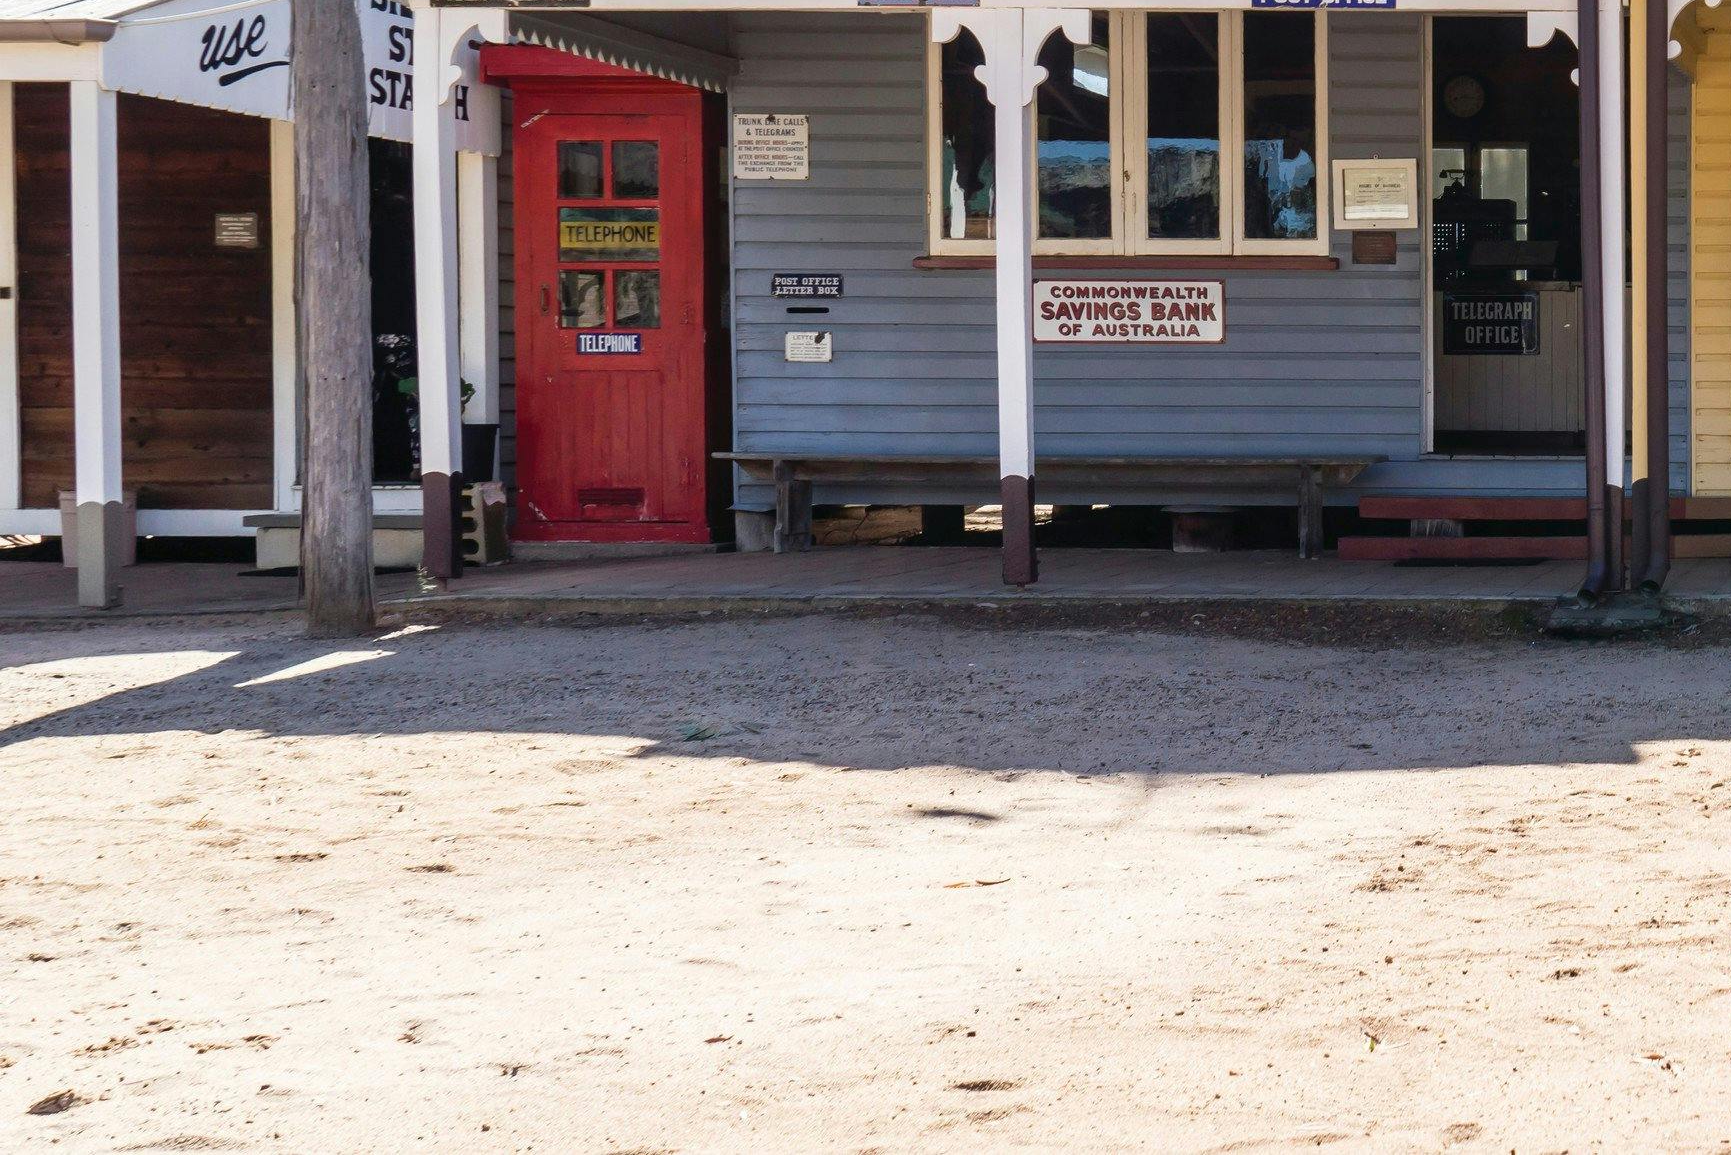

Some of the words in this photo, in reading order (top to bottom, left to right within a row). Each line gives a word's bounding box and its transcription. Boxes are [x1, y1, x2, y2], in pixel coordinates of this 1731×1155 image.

[199, 14, 268, 73] use
[738, 117, 762, 126] TRUNK
[783, 117, 805, 126] CALLS
[755, 128, 796, 136] TELEGRAMS
[566, 225, 656, 243] TELEPHONE
[774, 277, 799, 285] POST
[801, 277, 840, 285] OFFICE
[776, 286, 814, 295] LETTER
[817, 286, 839, 295] BOX
[1049, 285, 1208, 299] COMMONWEALTH
[1040, 301, 1142, 321] SAVINGS
[1150, 302, 1217, 321] BANK
[1451, 301, 1533, 320] TELEGRAPH
[1058, 323, 1083, 337] OF
[1092, 323, 1201, 337] AUSTRALIA
[1465, 326, 1520, 344] OFFICE
[579, 334, 639, 353] TELEPHONE
